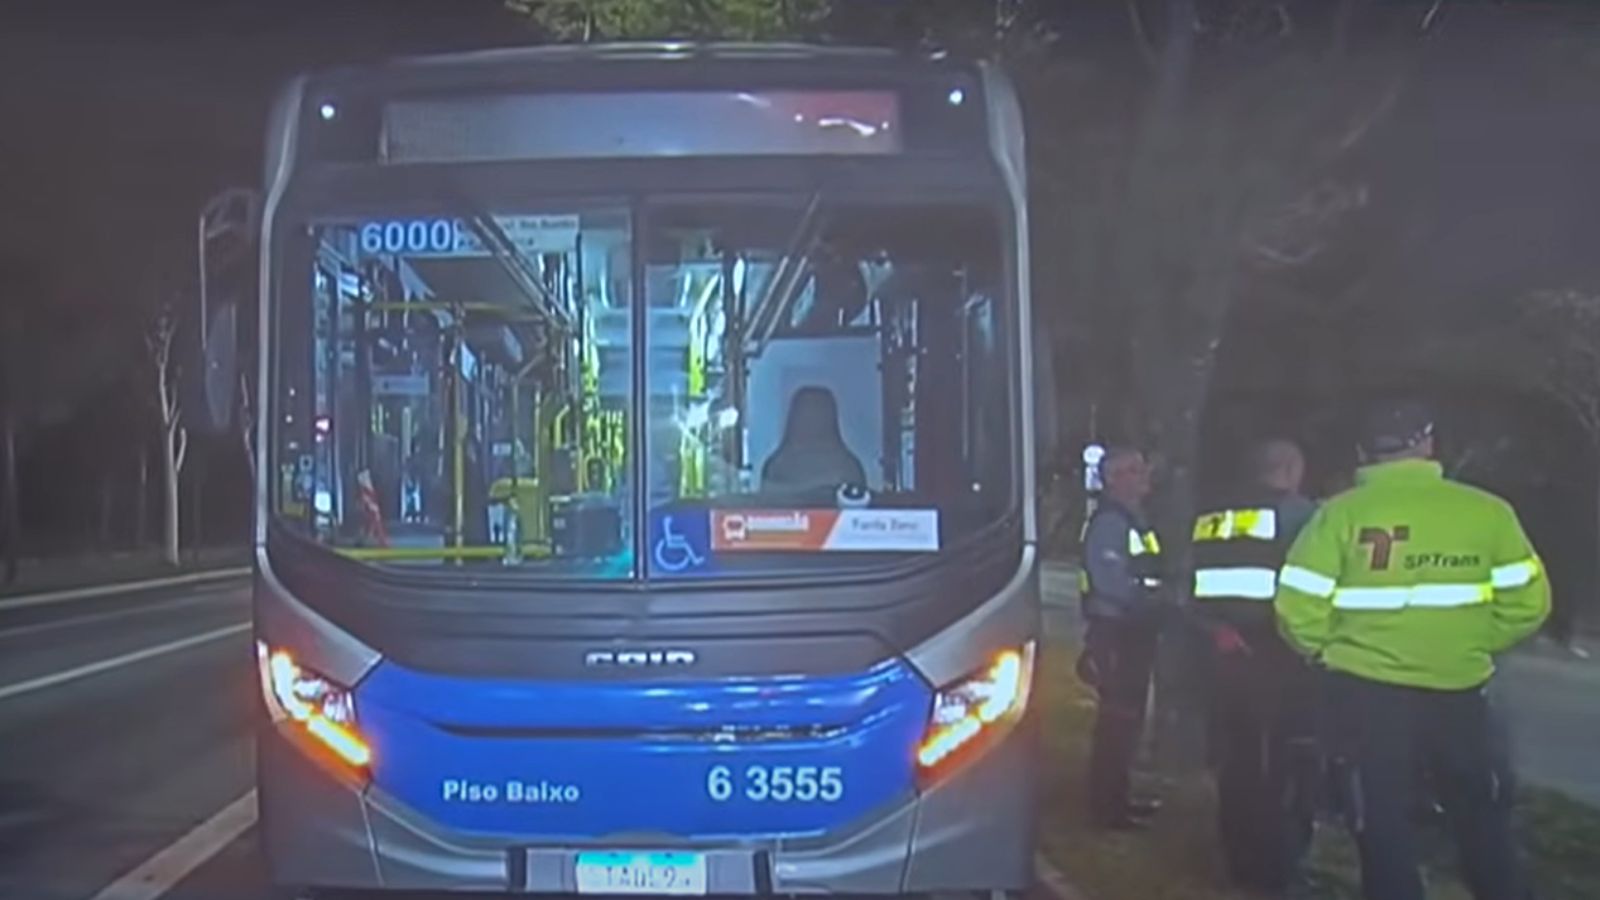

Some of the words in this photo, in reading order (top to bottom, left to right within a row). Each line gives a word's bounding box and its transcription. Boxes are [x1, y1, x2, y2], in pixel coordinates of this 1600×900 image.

[361, 221, 450, 251] 6000
[1403, 553, 1480, 570] SPTrans
[442, 779, 497, 802] Piso
[506, 781, 580, 802] Baixo
[707, 765, 732, 801] 6
[745, 765, 844, 801] 3555
